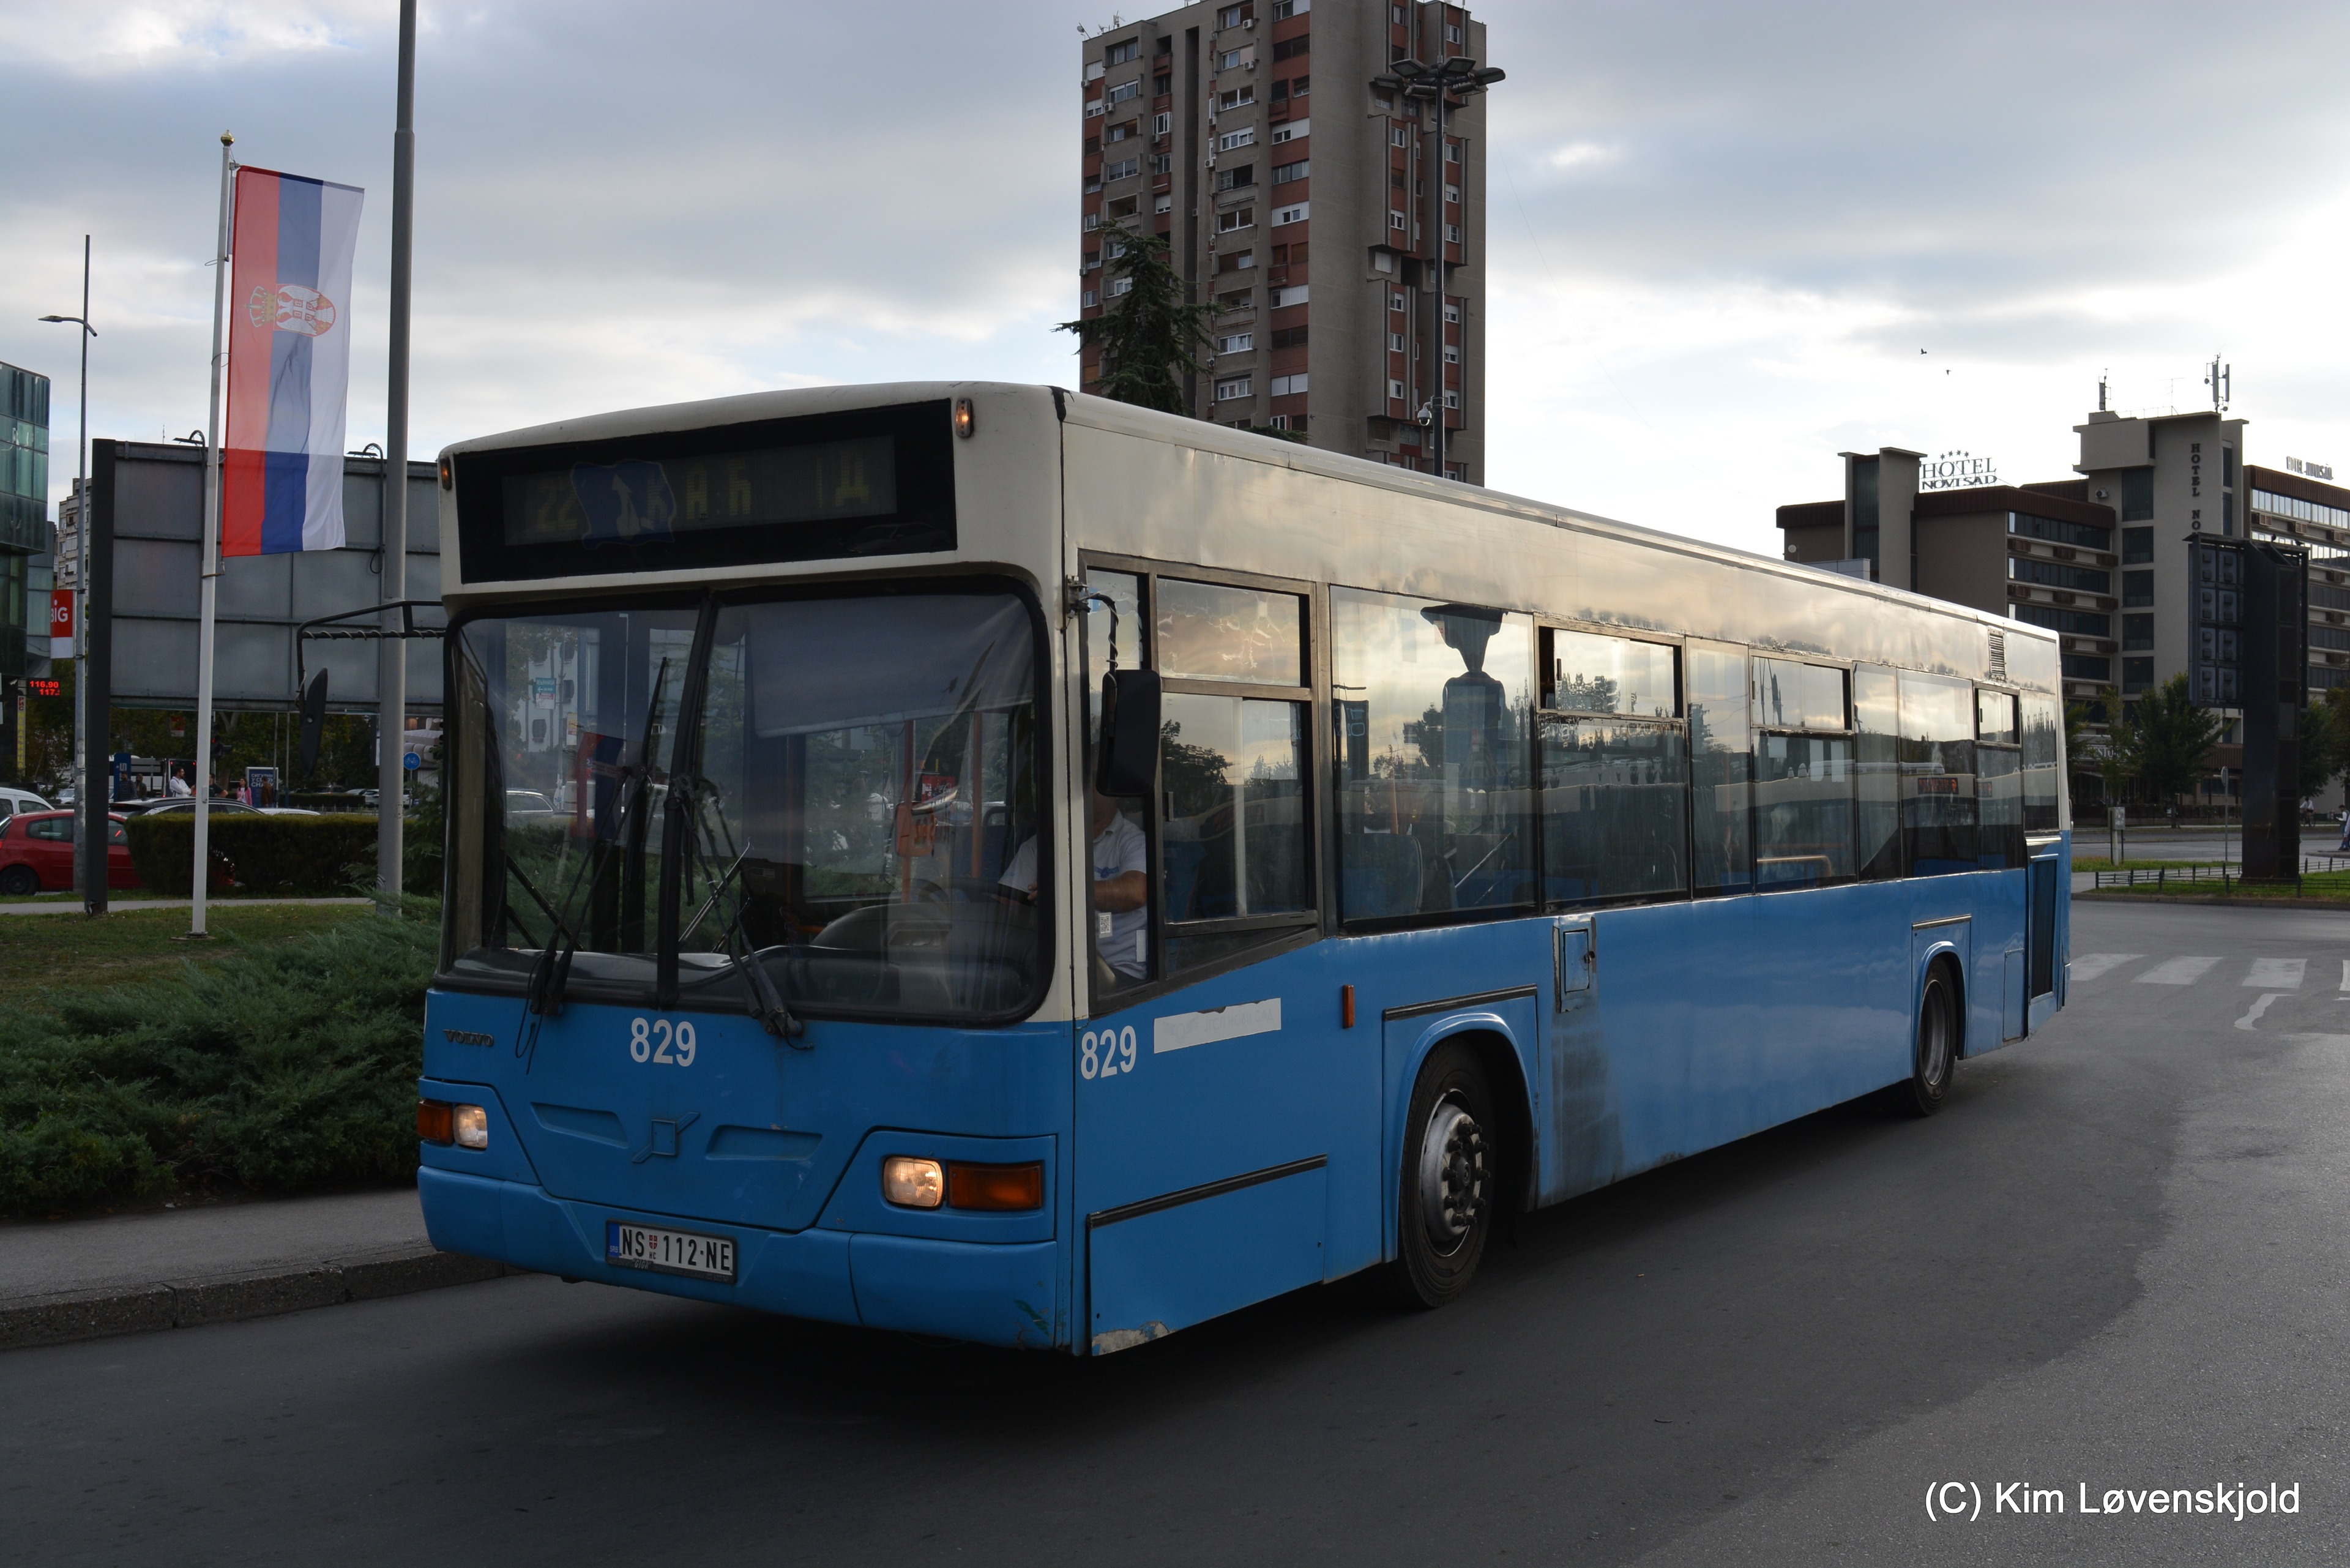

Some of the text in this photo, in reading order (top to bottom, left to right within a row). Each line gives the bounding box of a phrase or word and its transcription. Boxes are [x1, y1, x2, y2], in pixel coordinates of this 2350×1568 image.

[1921, 457, 1997, 479] HOTEL
[2286, 456, 2303, 474] HOTEL
[1922, 475, 1997, 490] NOVI SAD
[2190, 443, 2201, 534] HOTEL NO
[442, 1029, 494, 1047] VOLVO
[630, 1017, 696, 1067] 829
[1081, 1025, 1136, 1080] 829
[610, 1245, 619, 1253] SRB
[622, 1228, 644, 1256] NS
